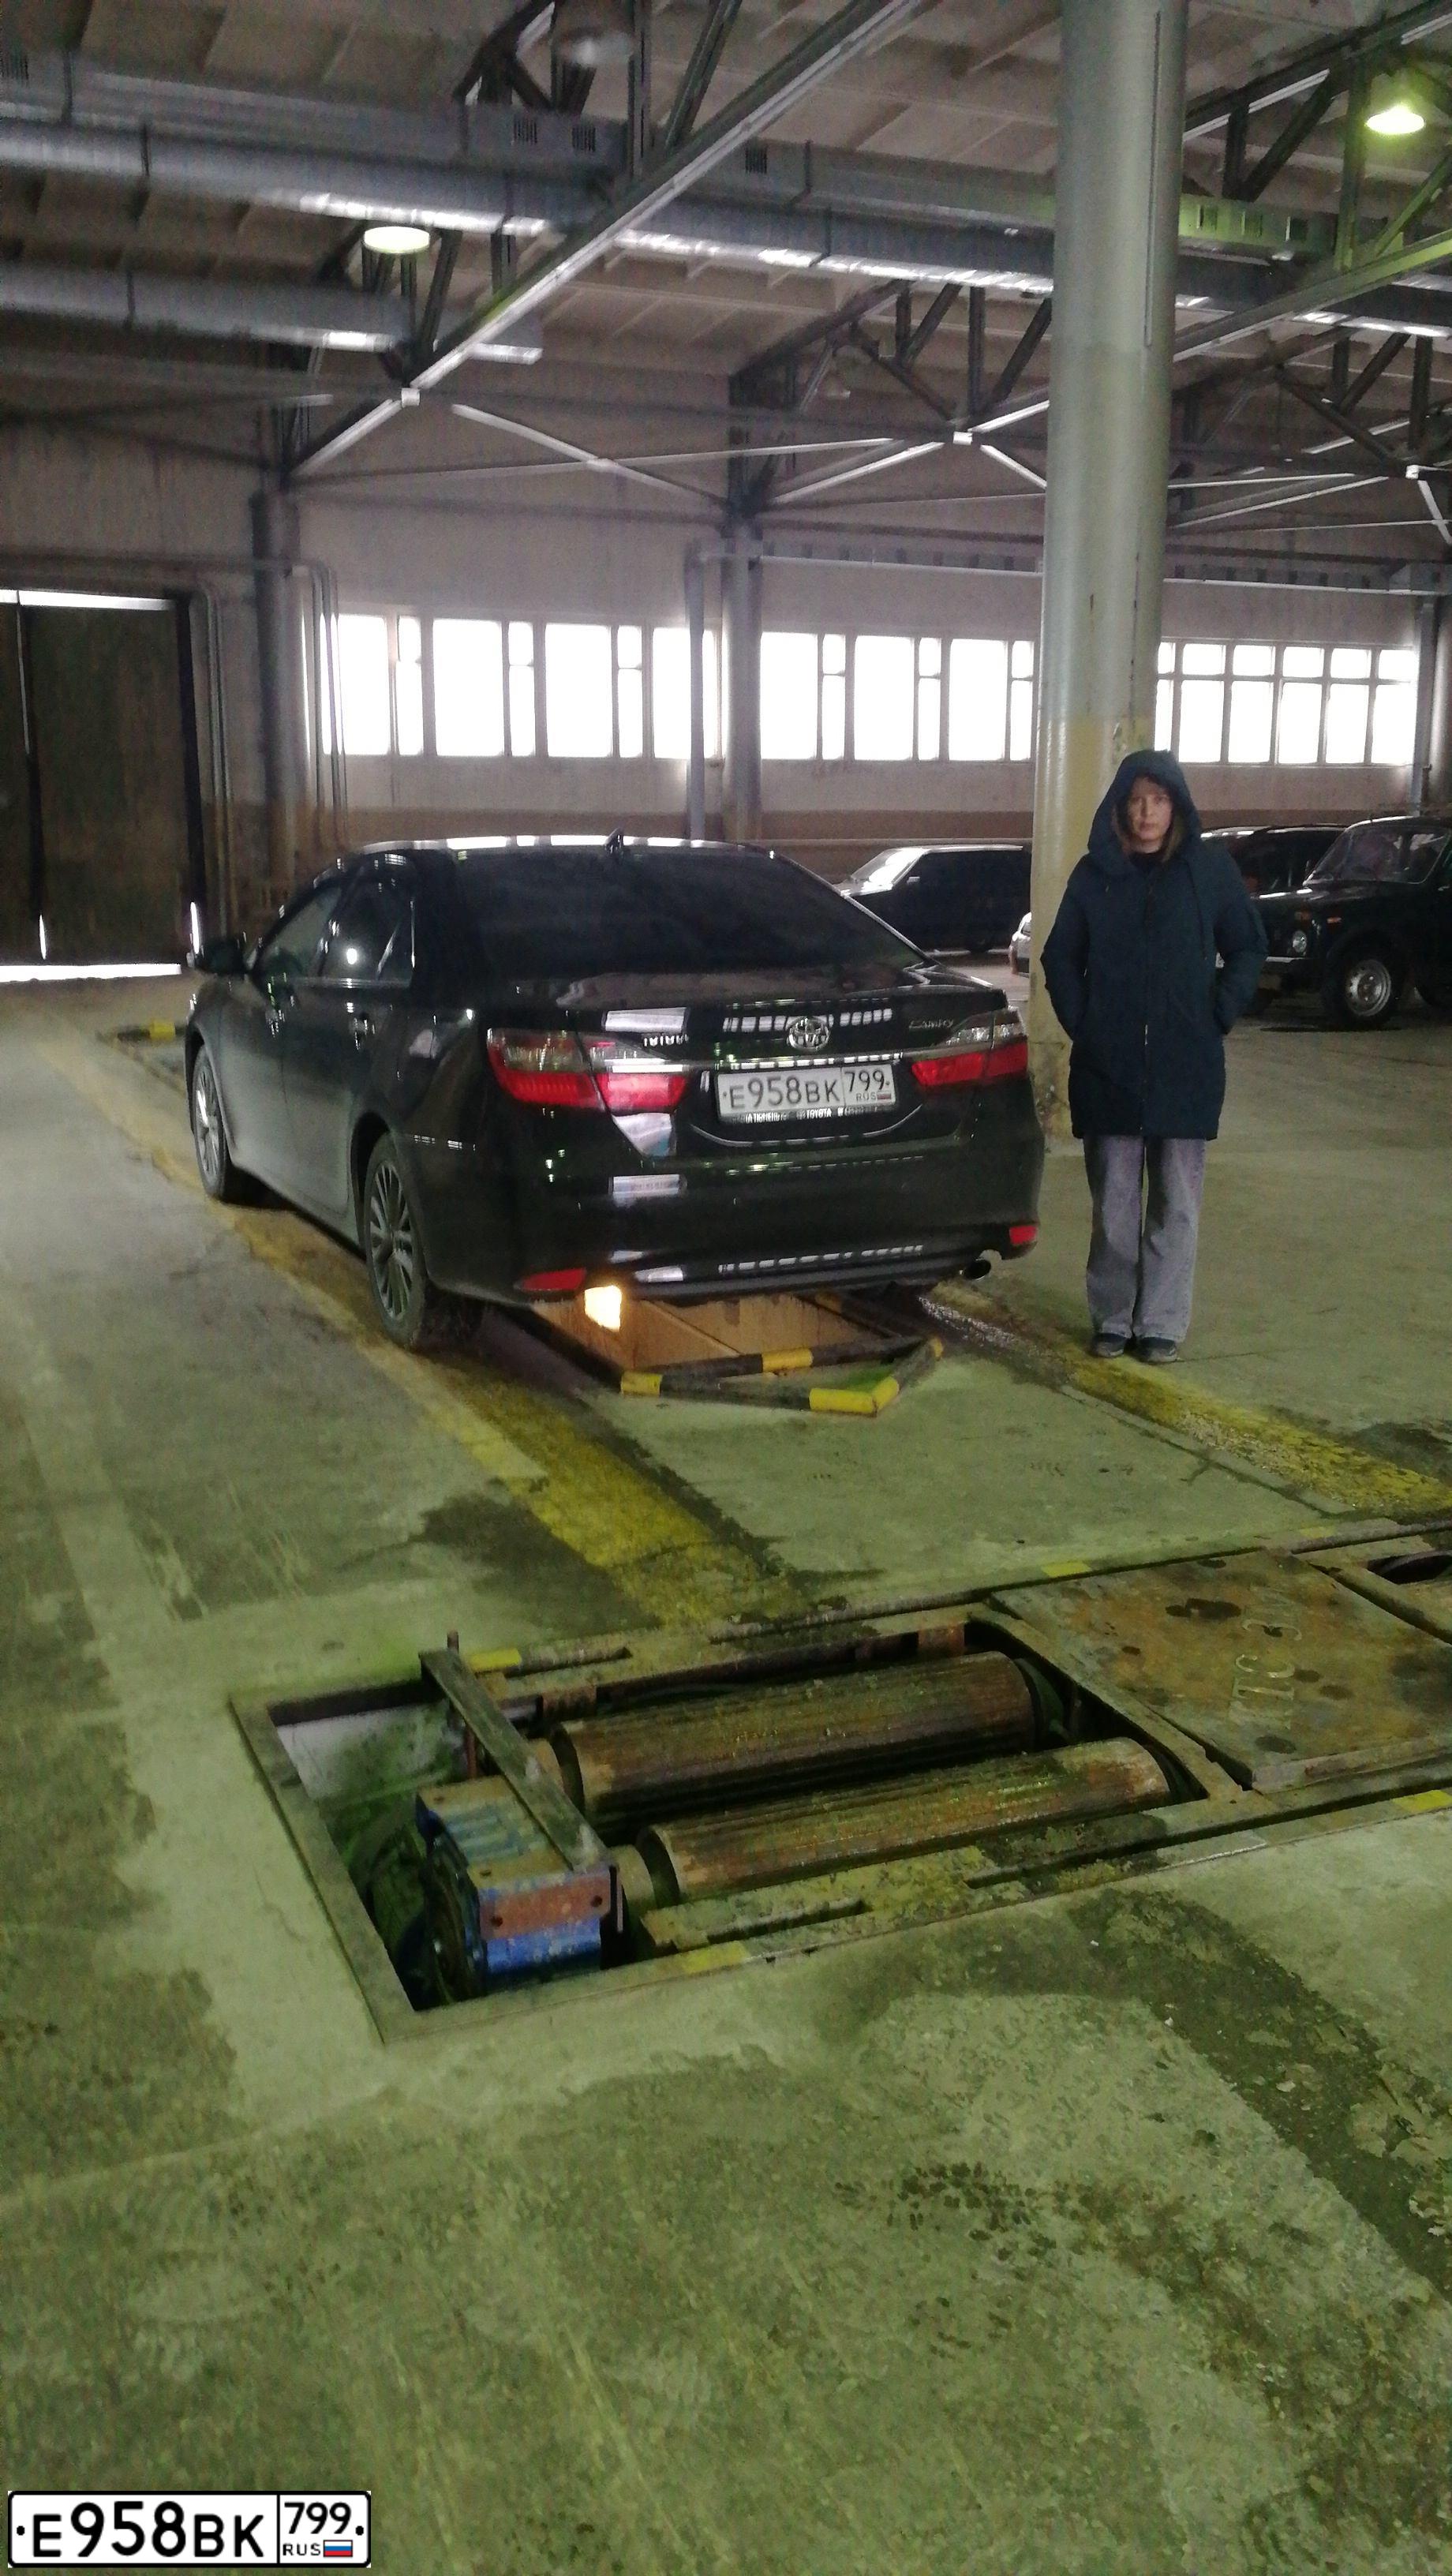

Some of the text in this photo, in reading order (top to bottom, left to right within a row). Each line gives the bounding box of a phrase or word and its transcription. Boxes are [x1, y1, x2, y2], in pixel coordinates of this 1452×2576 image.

[729, 1068, 885, 1109] E958BK 799
[855, 1091, 877, 1102] RUS
